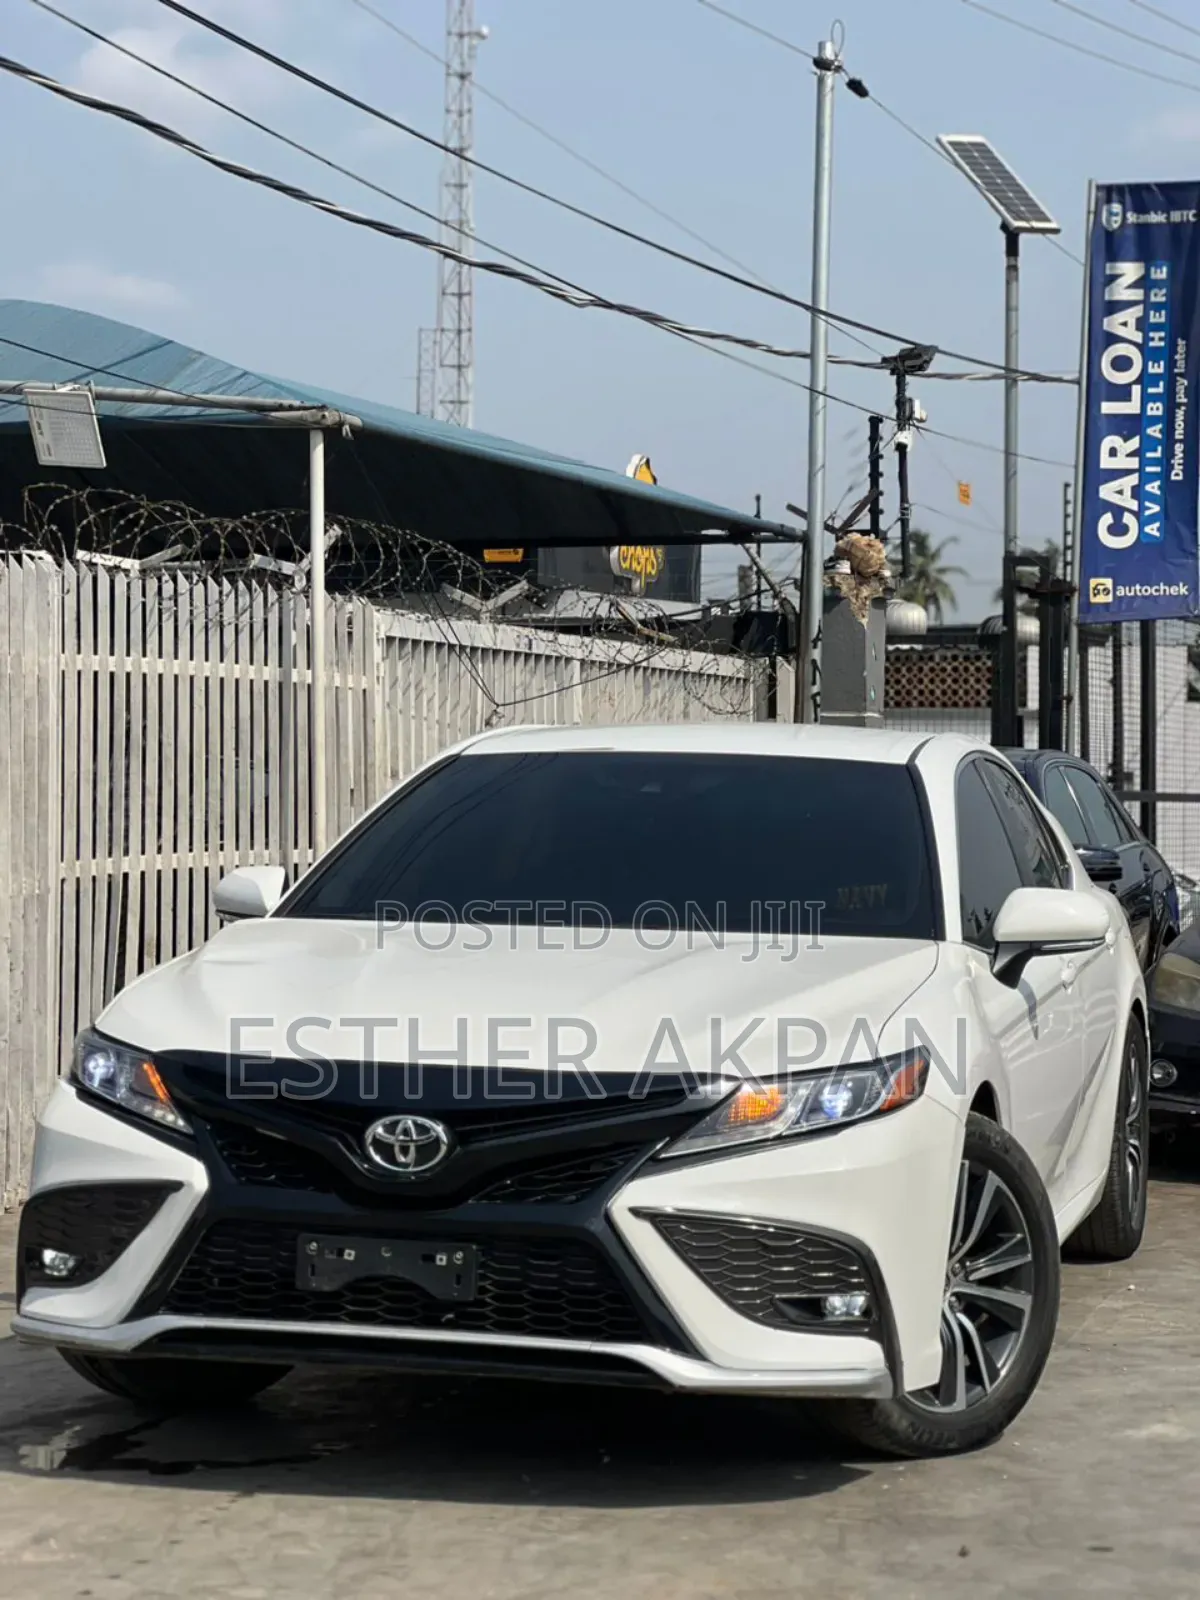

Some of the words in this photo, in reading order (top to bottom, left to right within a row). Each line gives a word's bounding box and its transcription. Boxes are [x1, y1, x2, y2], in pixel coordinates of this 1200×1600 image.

[1126, 210, 1167, 224] Stanbic
[1149, 266, 1167, 347] HERE
[1101, 263, 1145, 414] LOAN
[1174, 338, 1186, 372] later
[1176, 377, 1188, 403] pay
[1174, 406, 1186, 439] now,
[1144, 360, 1165, 536] AVAILABLE
[1171, 443, 1184, 480] Drive
[1097, 434, 1141, 550] CAR
[1116, 582, 1188, 597] autochek
